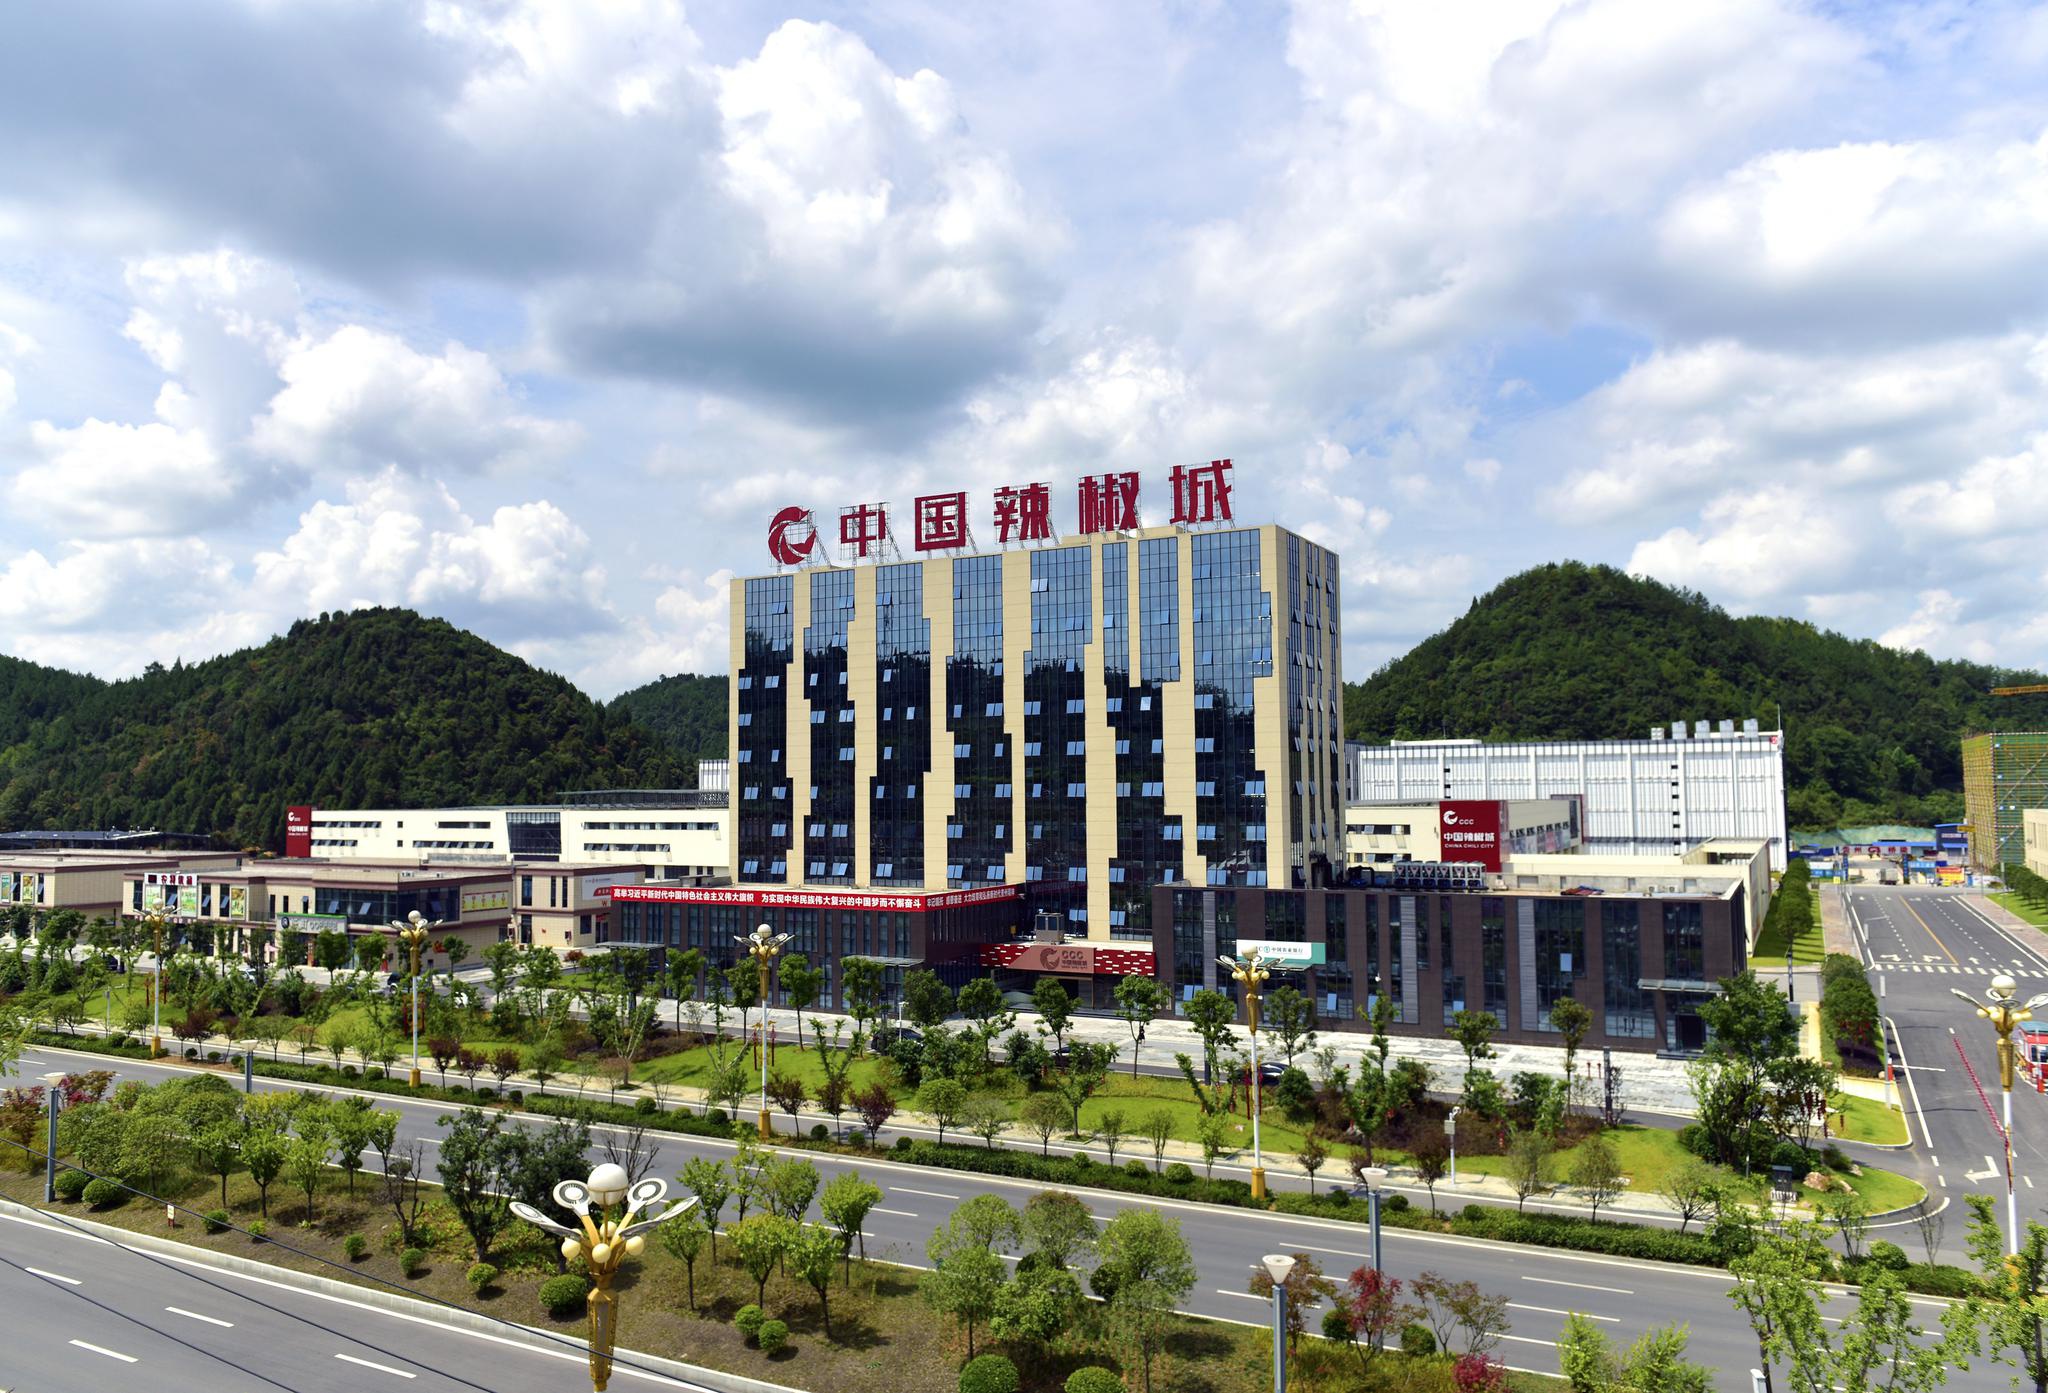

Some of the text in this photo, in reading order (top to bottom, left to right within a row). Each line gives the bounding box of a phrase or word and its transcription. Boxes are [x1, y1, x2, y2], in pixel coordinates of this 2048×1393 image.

[839, 459, 1233, 557] 中国辣椒城
[1443, 832, 1495, 842] 中国辣椒城
[761, 893, 922, 909] 为实现中华民族伟大复兴的中国梦而不懈奋斗
[1061, 950, 1084, 960] CCC
